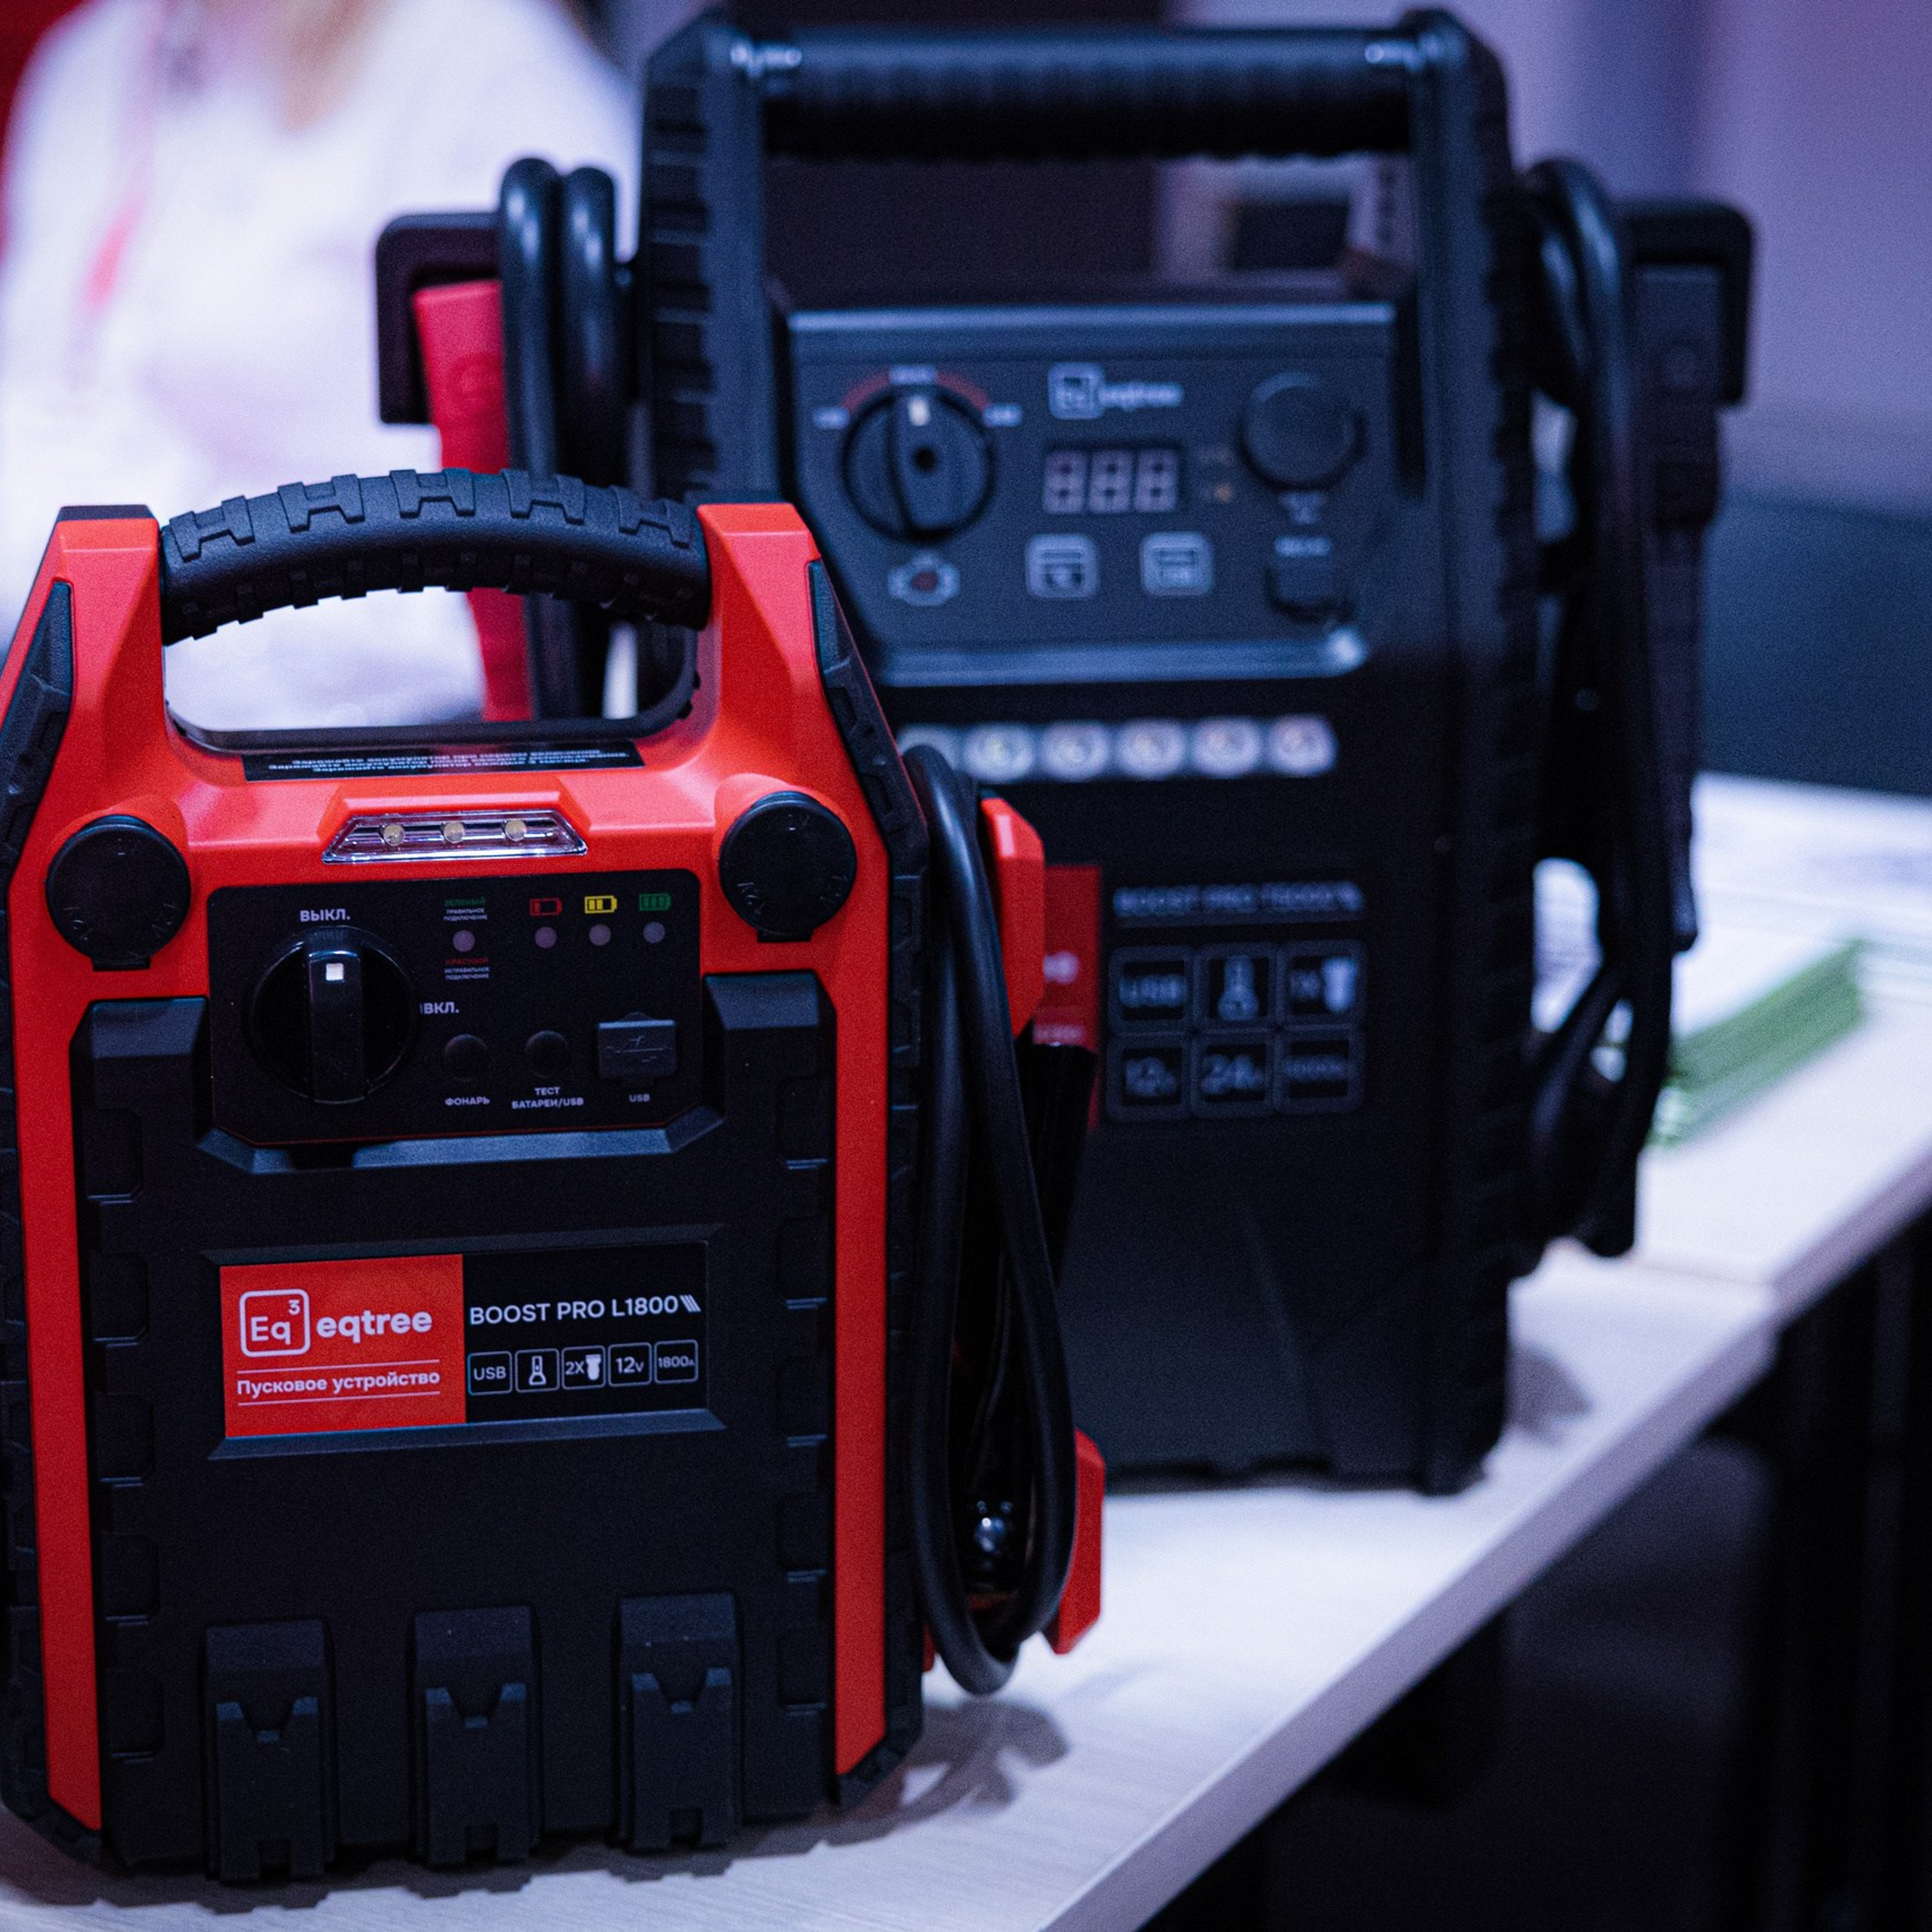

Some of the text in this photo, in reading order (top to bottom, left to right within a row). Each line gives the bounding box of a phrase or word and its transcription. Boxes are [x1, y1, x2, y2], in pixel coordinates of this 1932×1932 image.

[300, 909, 350, 921] ВЫКЛ.
[423, 1002, 459, 1014] ВКЛ.
[534, 1087, 561, 1096] ТЕСТ
[445, 1097, 491, 1106] ФОНАРЬ
[512, 1097, 584, 1109] БАТАРЕИ/USB
[629, 1094, 651, 1103] USB
[469, 1295, 678, 1325] BOOST PRO L1800
[316, 1309, 432, 1343] eqtree
[473, 1366, 506, 1381] USB
[237, 1371, 441, 1398] Пусковое устройство
